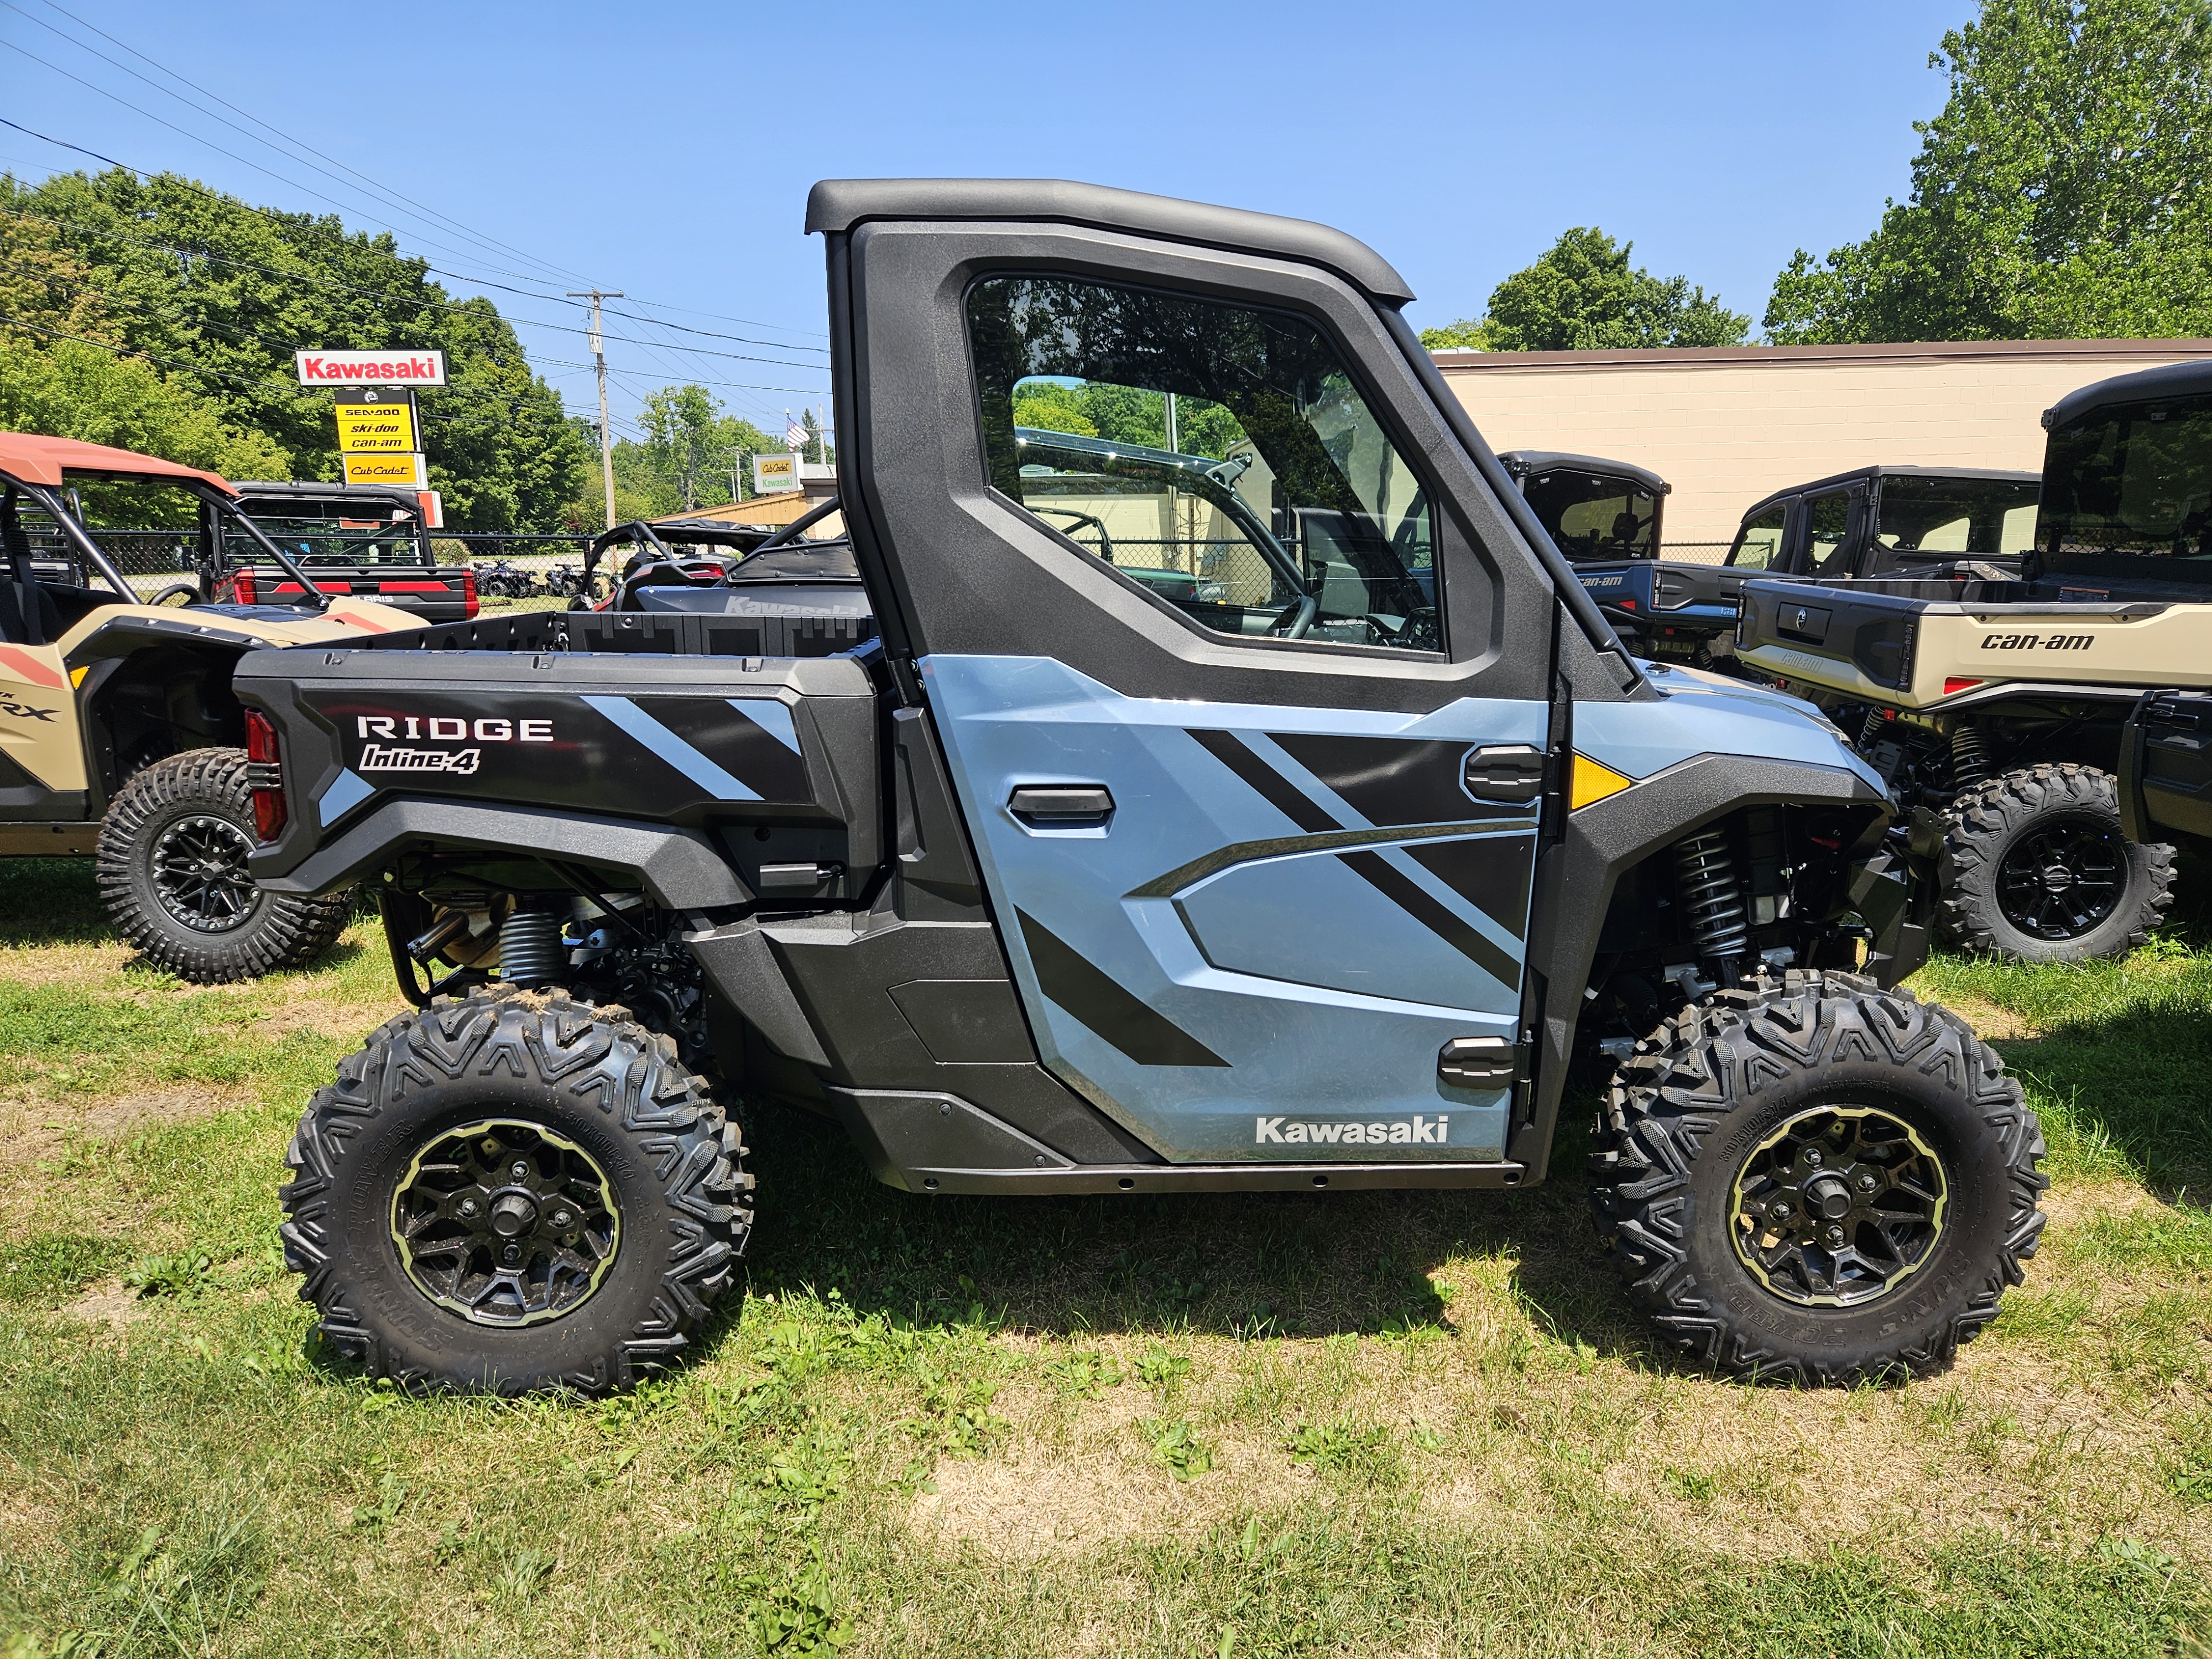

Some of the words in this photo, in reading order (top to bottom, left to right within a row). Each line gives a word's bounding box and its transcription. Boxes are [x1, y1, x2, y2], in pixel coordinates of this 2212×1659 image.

[305, 358, 435, 379] Kawasaki
[351, 424, 399, 432] ski-doo
[763, 464, 773, 473] Cub
[773, 463, 790, 472] Cadet
[763, 477, 792, 488] Kawasaki
[1981, 635, 2095, 650] can-am
[1782, 651, 1824, 673] can-am
[357, 716, 554, 742] RIDGE
[359, 744, 480, 774] Inline-4
[1255, 1115, 1448, 1144] Kawasaki
[347, 1120, 414, 1234] POWER
